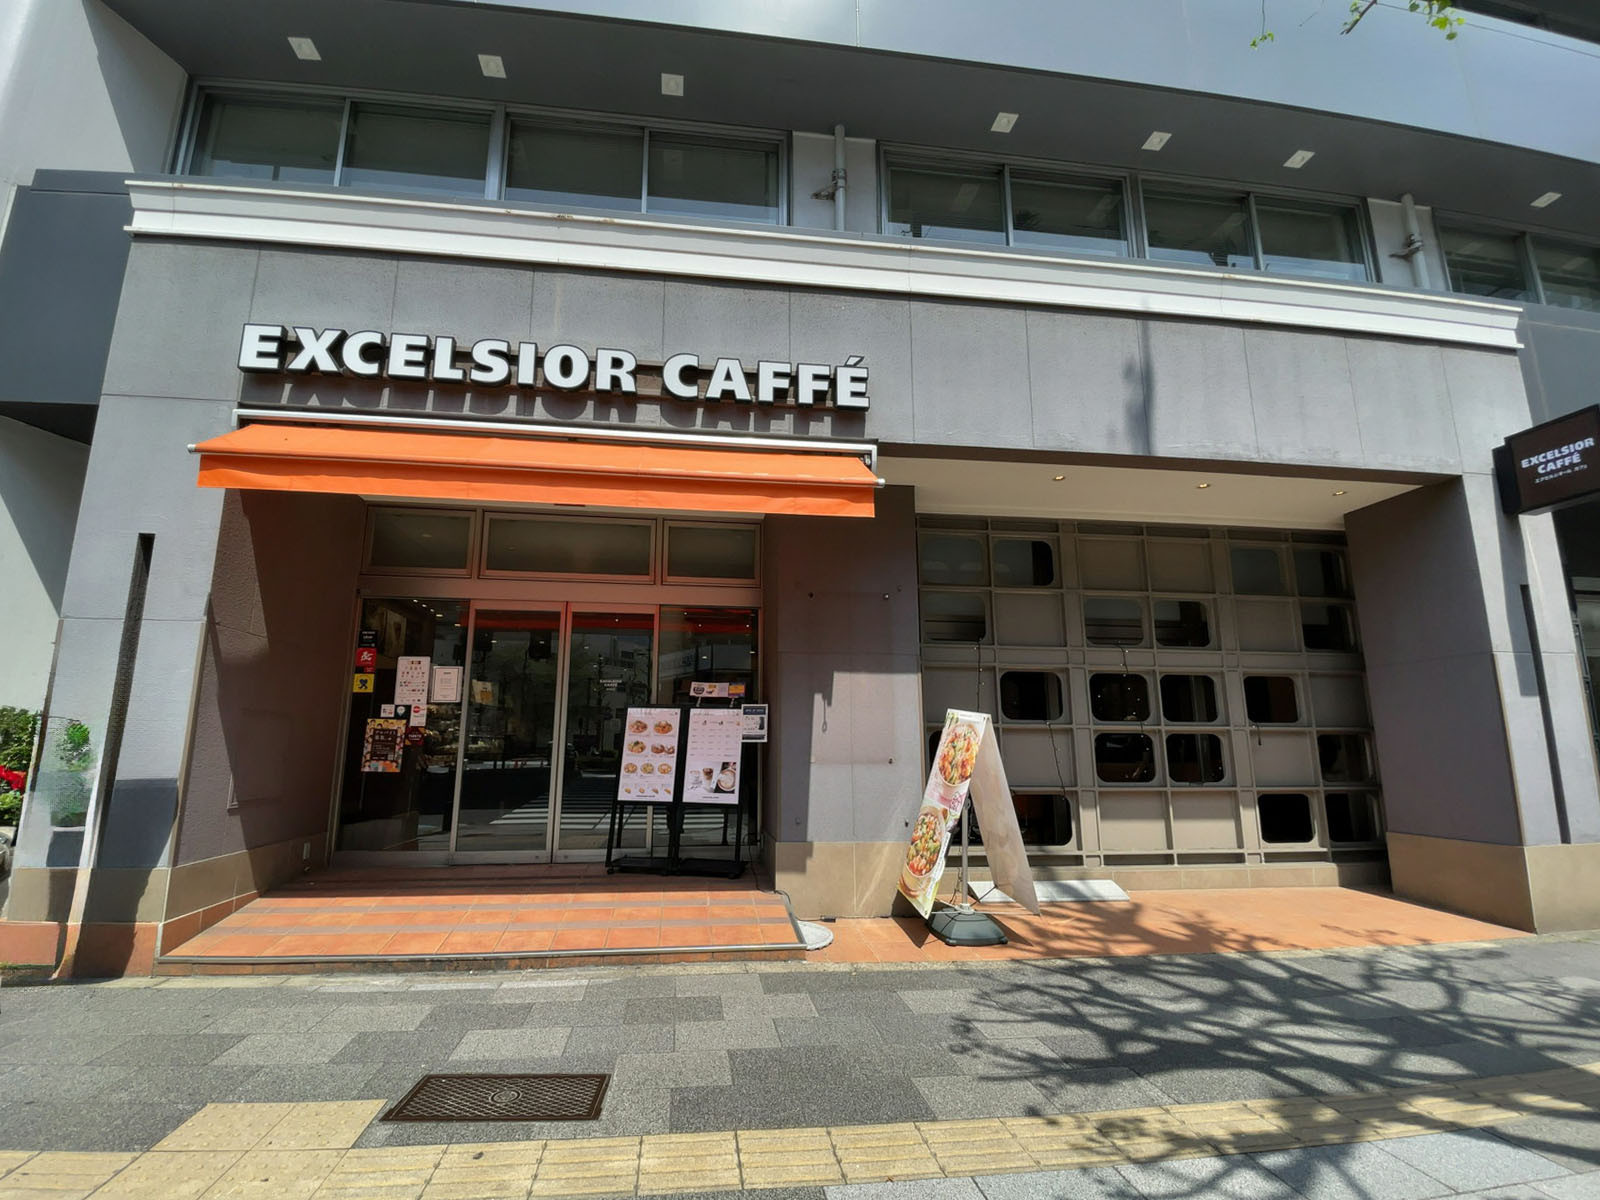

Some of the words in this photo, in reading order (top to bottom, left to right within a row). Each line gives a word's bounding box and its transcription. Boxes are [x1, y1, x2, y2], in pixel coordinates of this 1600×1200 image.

[238, 323, 637, 393] EXCELSIOR
[662, 353, 870, 410] CAFFÉ
[1521, 437, 1594, 468] EXCELSIOR
[1537, 451, 1581, 473] CAFFÉ
